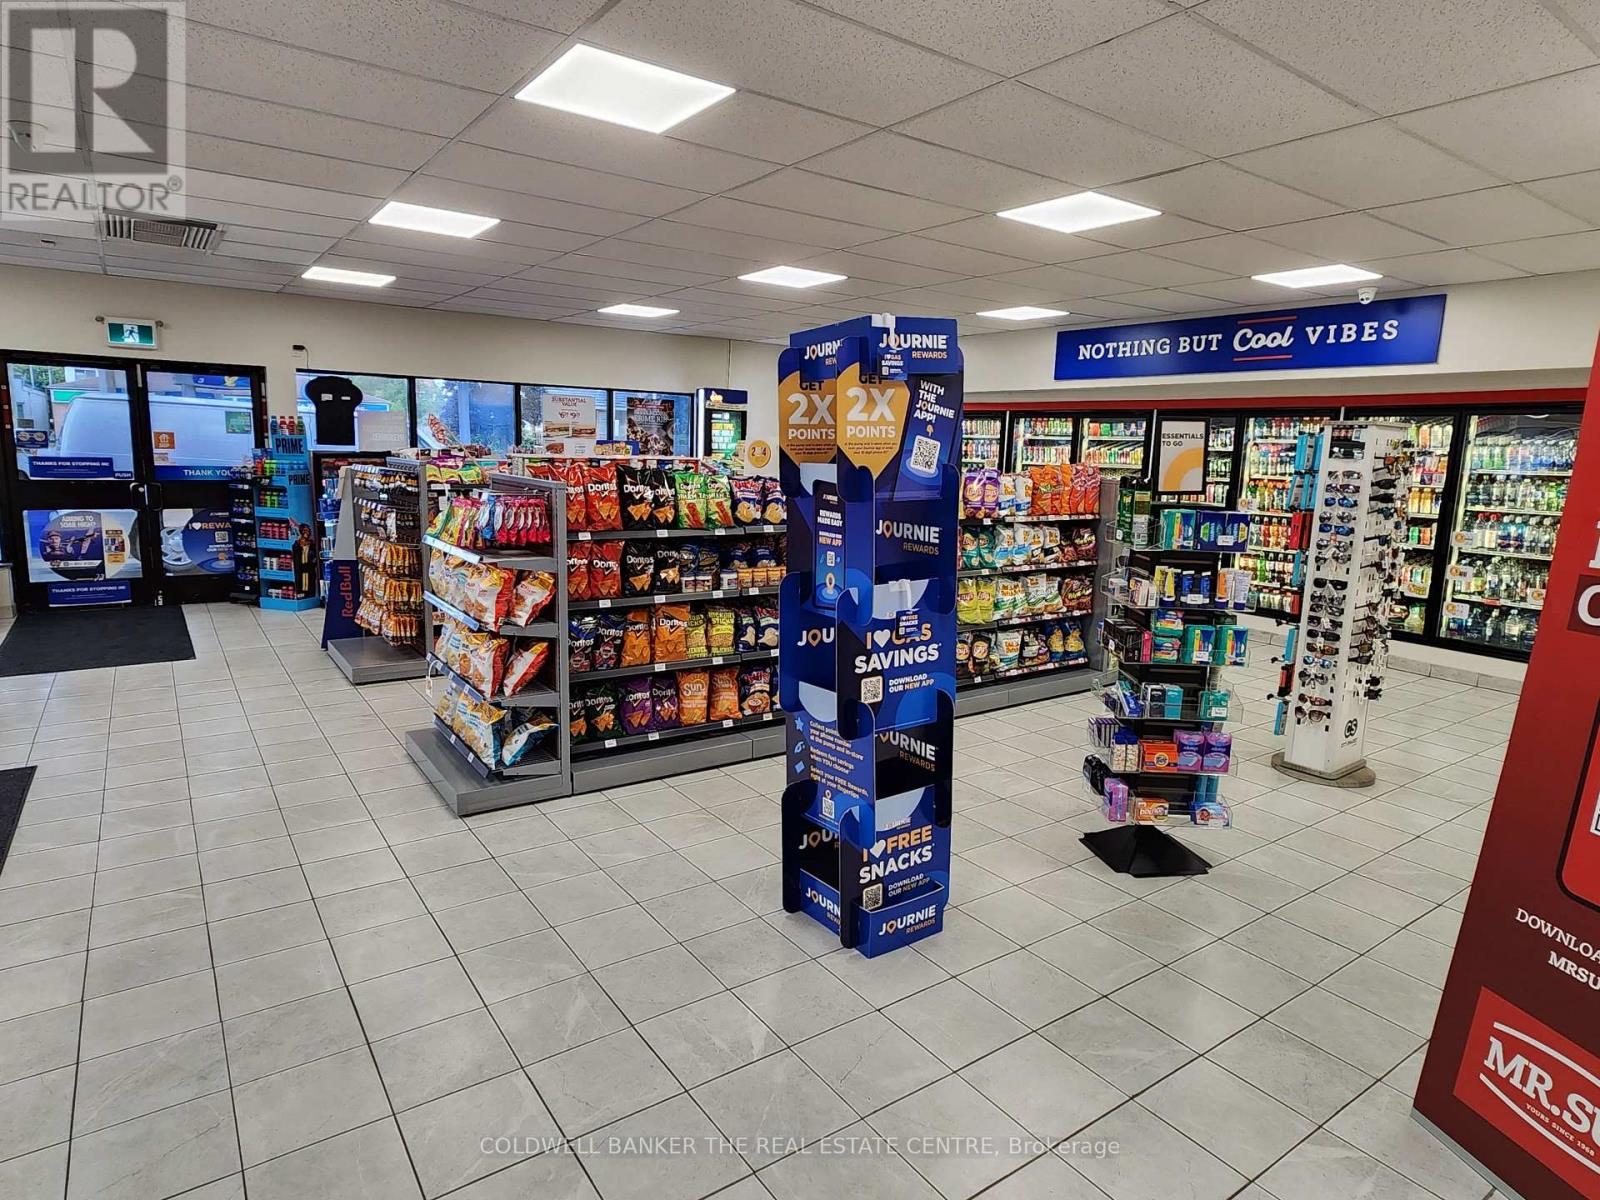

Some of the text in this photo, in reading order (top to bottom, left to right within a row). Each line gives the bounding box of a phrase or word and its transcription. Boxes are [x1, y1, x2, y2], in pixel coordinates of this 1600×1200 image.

[1078, 319, 1399, 360] NOTHING BUT Cool VIBES
[804, 339, 843, 360] JOURN
[912, 351, 948, 359] REWARDS
[800, 381, 824, 391] GET
[859, 374, 883, 384] GET
[920, 380, 945, 396] WITH
[846, 387, 896, 422] 2X
[919, 389, 937, 403] THE
[788, 394, 836, 425] 2X
[913, 409, 937, 424] APP!
[915, 400, 956, 419] JOURNIE
[788, 429, 836, 440] POINTS
[846, 426, 896, 438] POINTS
[275, 438, 305, 455] PRIME
[289, 474, 310, 485] PRIME
[876, 520, 940, 543] JOURNIE
[903, 542, 939, 556] REWARDS
[626, 555, 654, 565] Doritos
[660, 618, 688, 627] Doritos
[797, 627, 835, 647] JOU
[866, 623, 932, 649] I GS
[854, 644, 940, 674] SAVINGS
[889, 673, 928, 686] DOWNLOAD
[889, 679, 935, 693] OUR NEW APP
[628, 692, 650, 701] oritos
[683, 683, 703, 696] Sun
[585, 697, 613, 706] Doritos
[875, 730, 936, 761] OURNIE
[900, 751, 936, 771] REWARDS
[799, 829, 840, 850] JOU
[887, 824, 932, 855] FREE
[859, 845, 932, 884] SNACKS
[888, 873, 924, 891] DOWNLOAD
[888, 877, 931, 897] OUR NEW APP
[805, 888, 840, 915] JOURN
[826, 911, 840, 924] REWA
[878, 905, 936, 936] JOURNIE
[905, 918, 936, 935] REWARDS
[1515, 907, 1600, 964] DOWNLOA
[1547, 950, 1600, 990] MRSU
[1526, 1103, 1595, 1157] YOURS SINCE 1968
